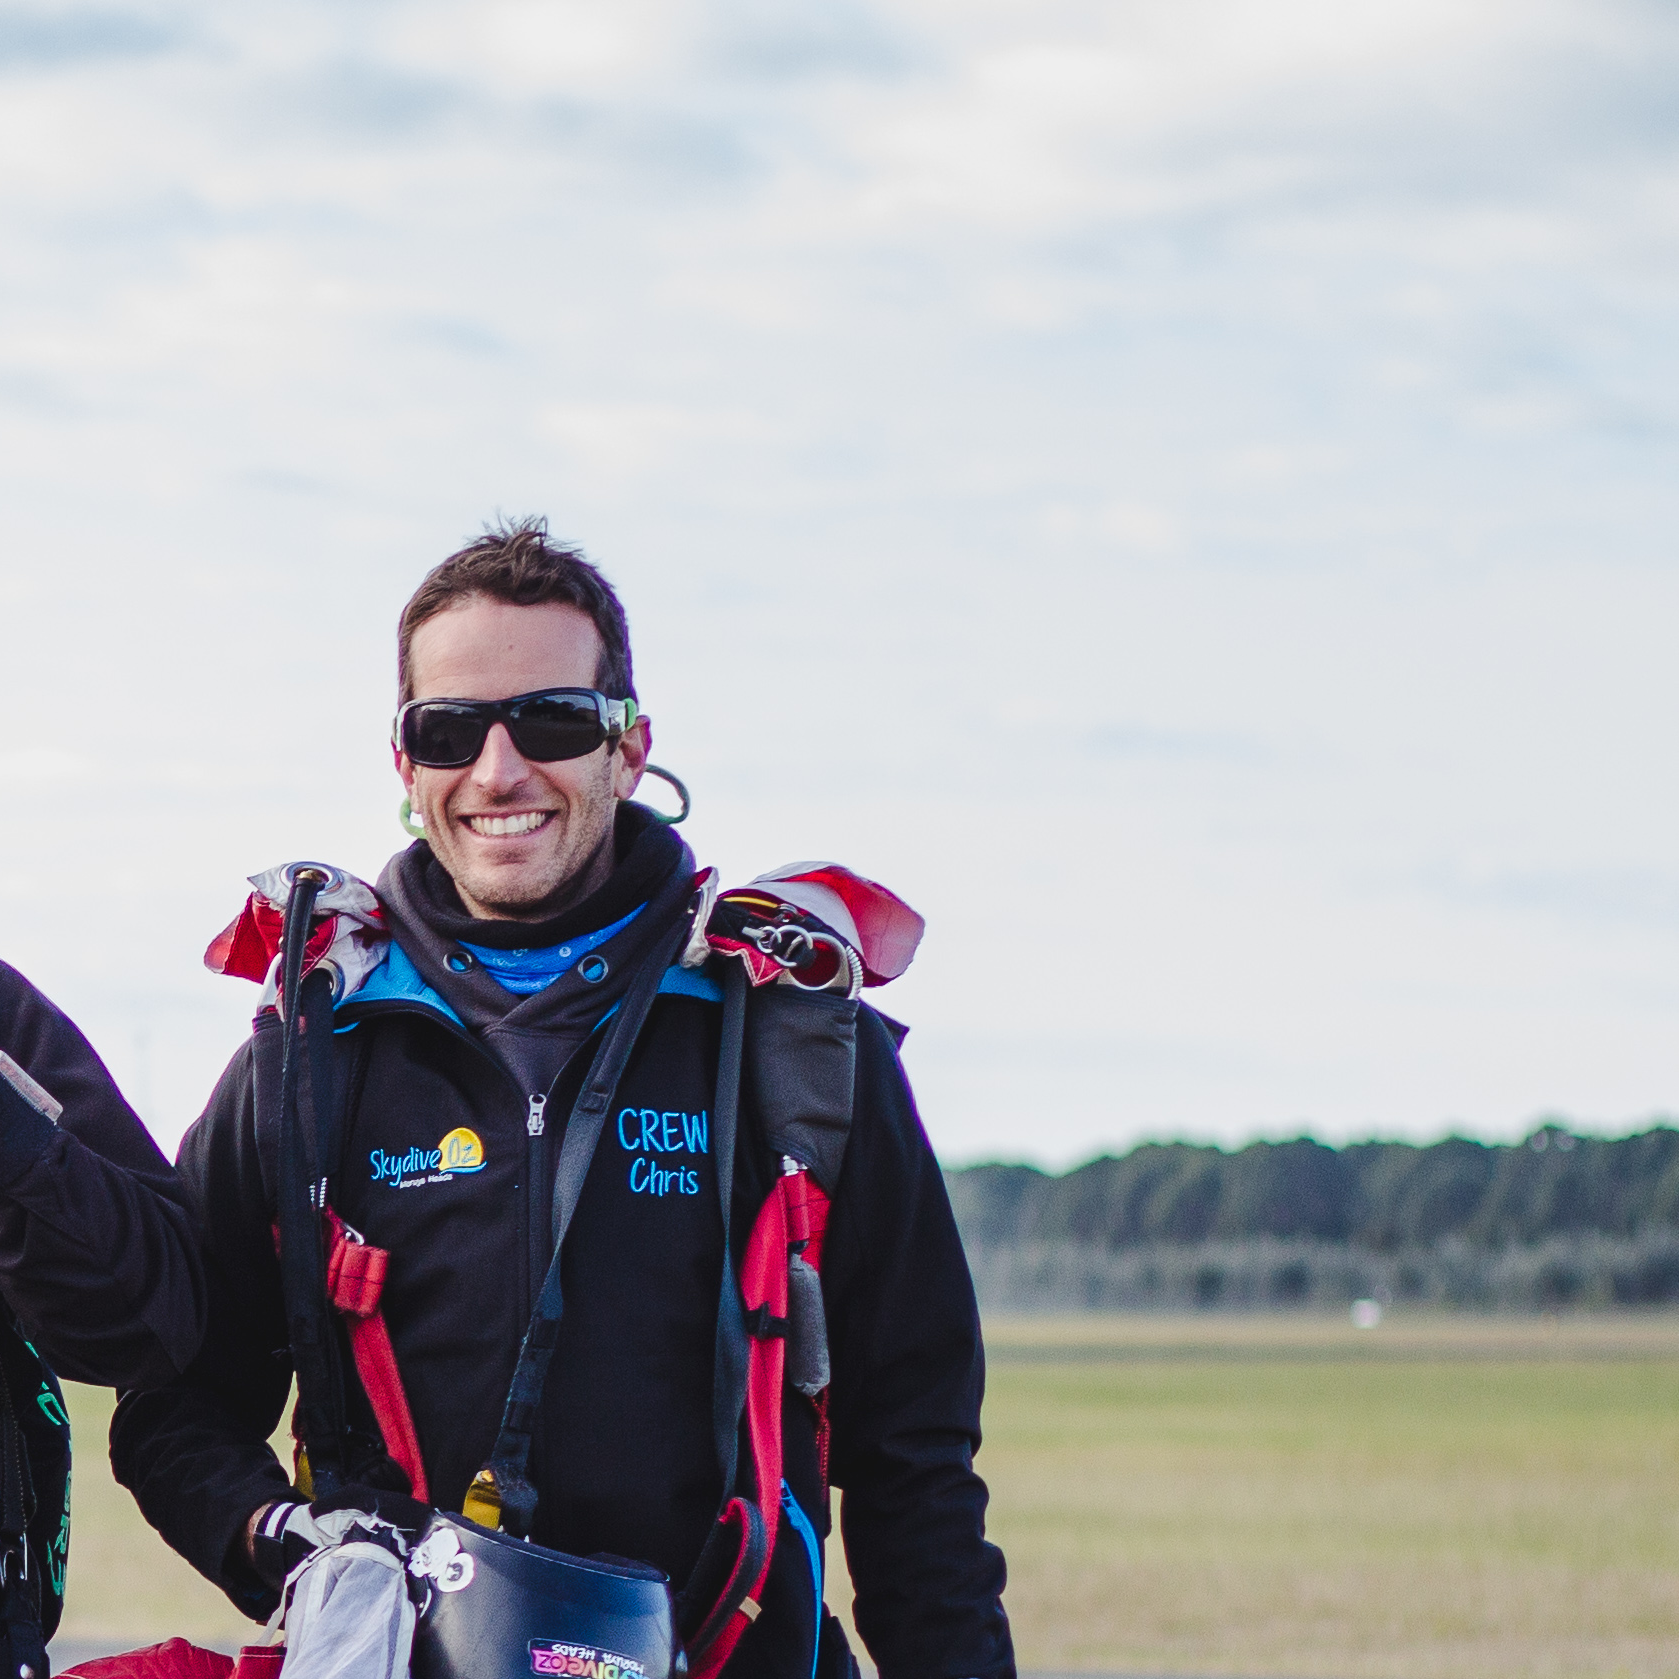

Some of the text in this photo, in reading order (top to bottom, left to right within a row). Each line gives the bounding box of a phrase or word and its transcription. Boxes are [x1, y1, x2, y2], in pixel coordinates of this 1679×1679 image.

[617, 1106, 709, 1154] CREW
[369, 1146, 442, 1187] Skydive
[629, 1157, 700, 1197] Chris
[551, 1643, 596, 1660] HEADS
